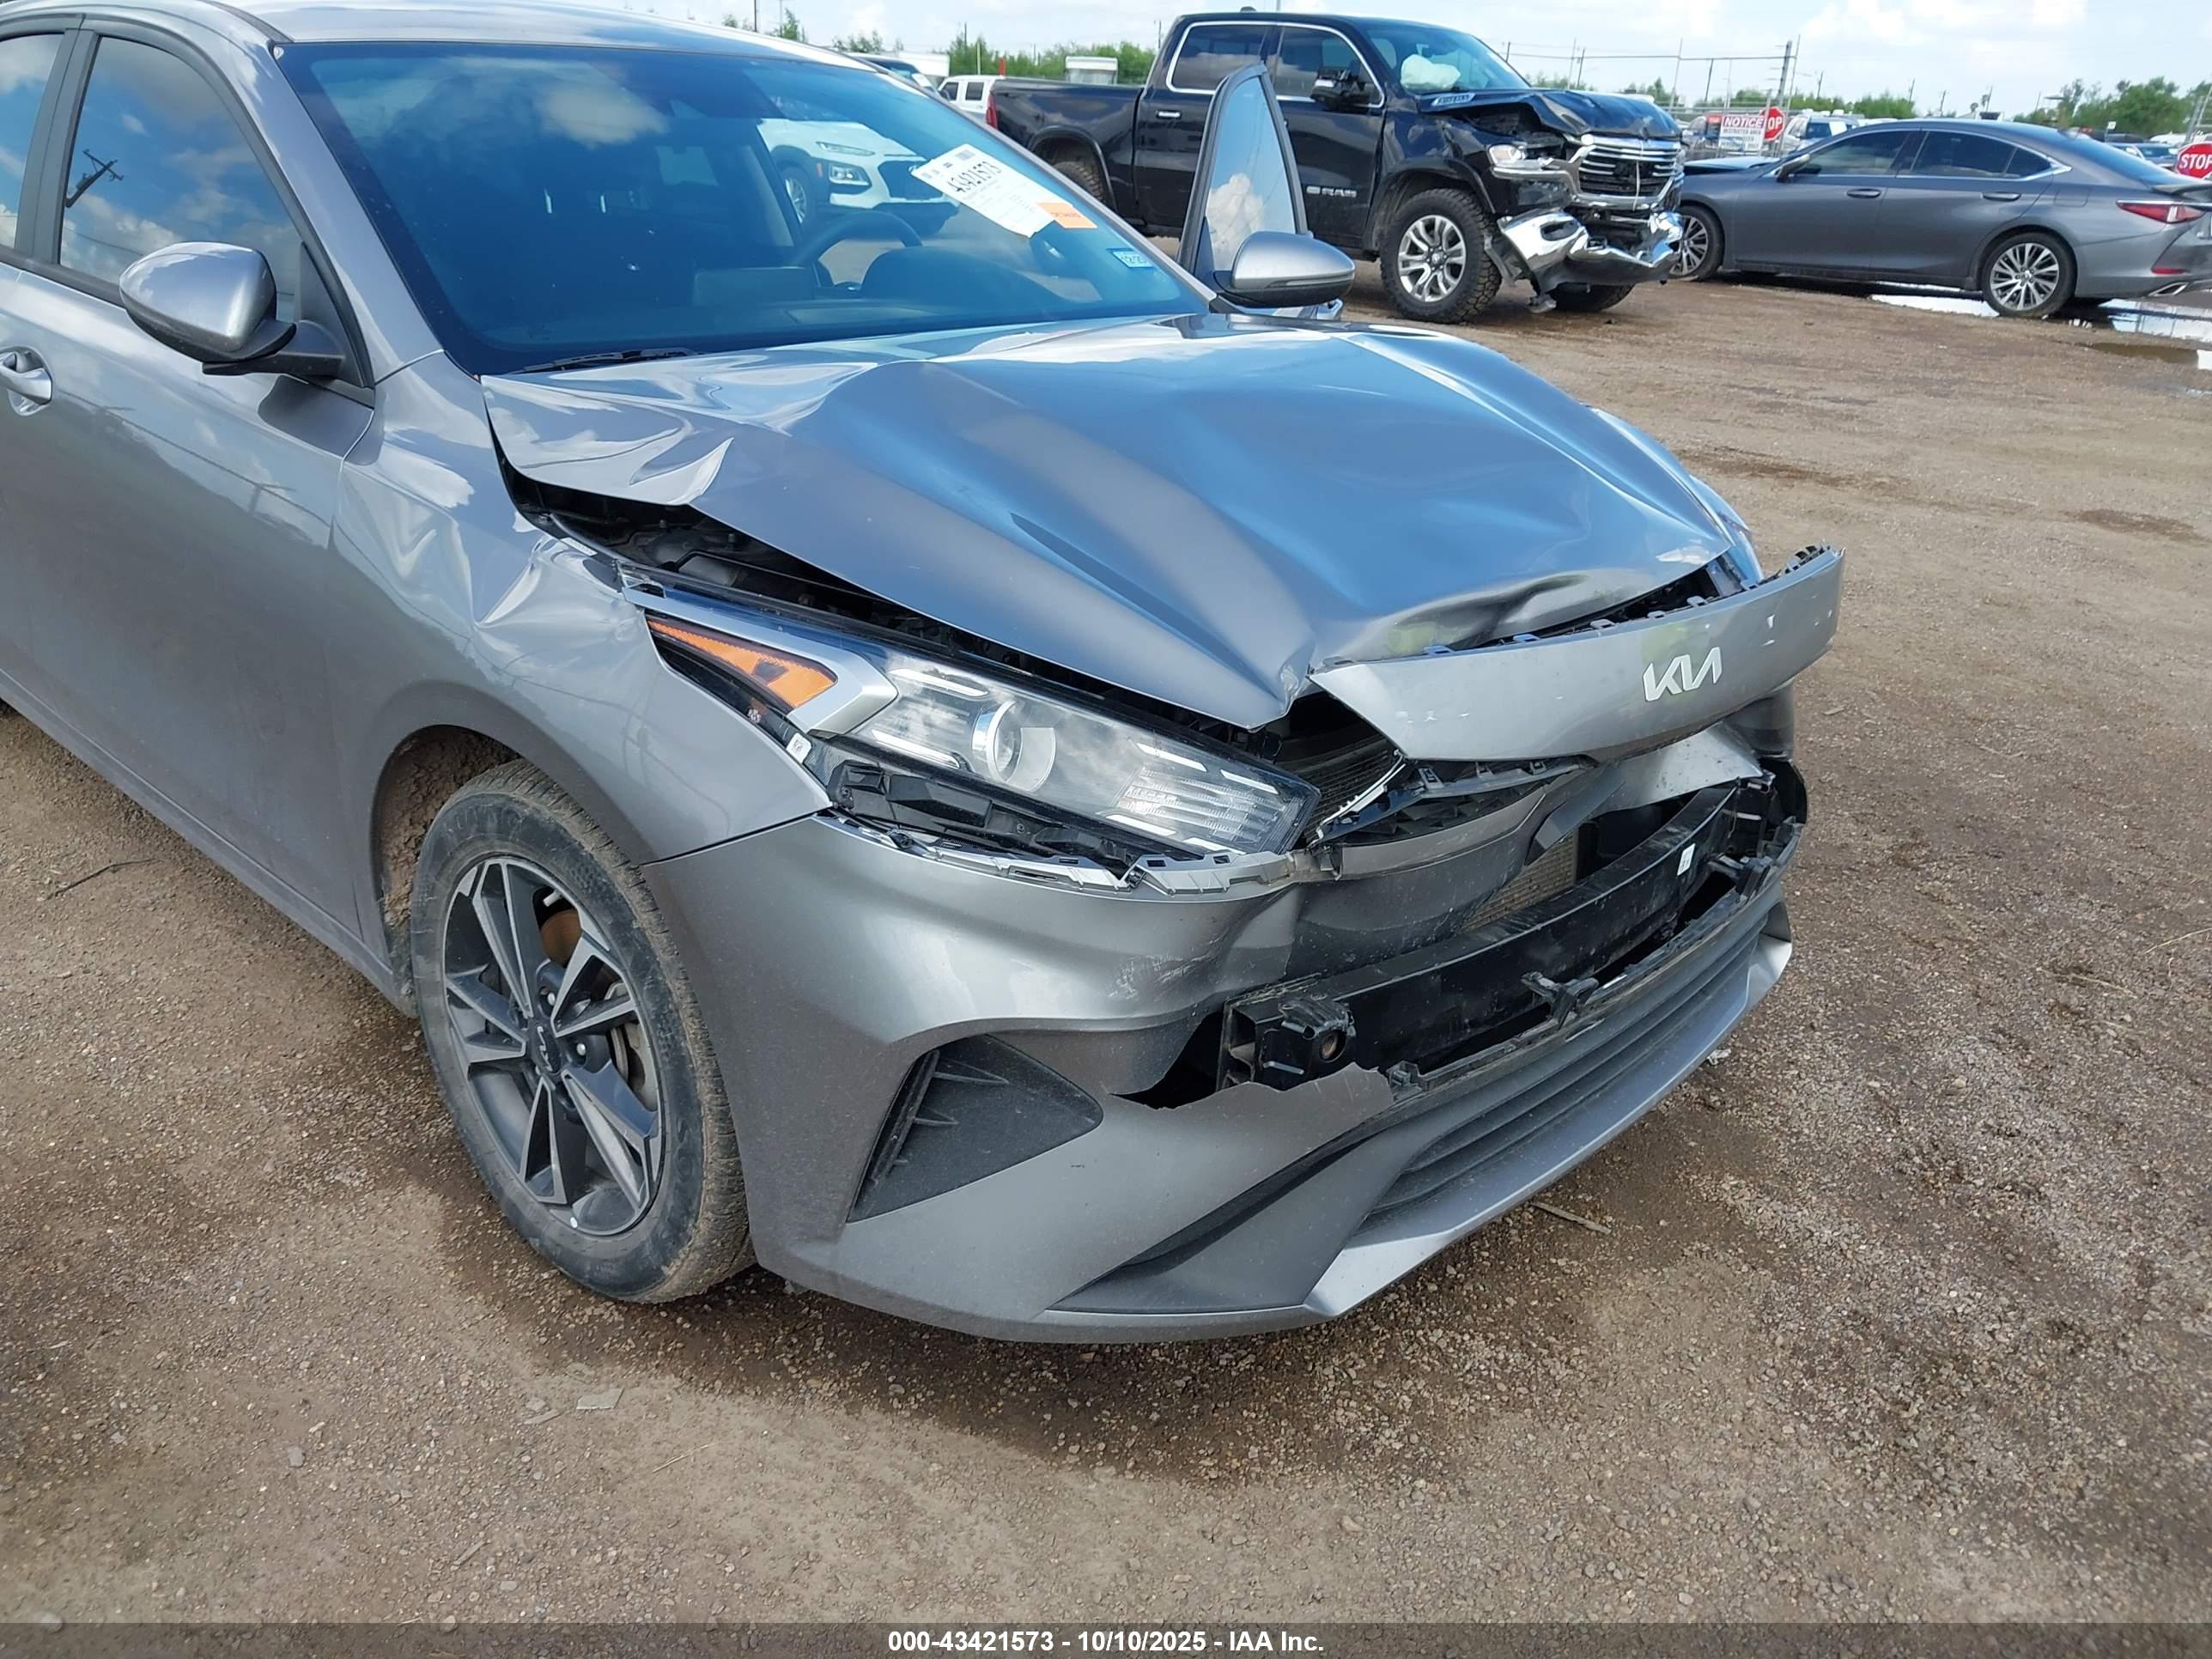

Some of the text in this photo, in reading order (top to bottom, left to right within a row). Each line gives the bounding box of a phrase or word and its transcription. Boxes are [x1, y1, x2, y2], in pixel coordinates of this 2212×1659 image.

[1724, 116, 1764, 127] NOTICE
[1767, 116, 1783, 130] OP
[1322, 186, 1357, 198] RAM
